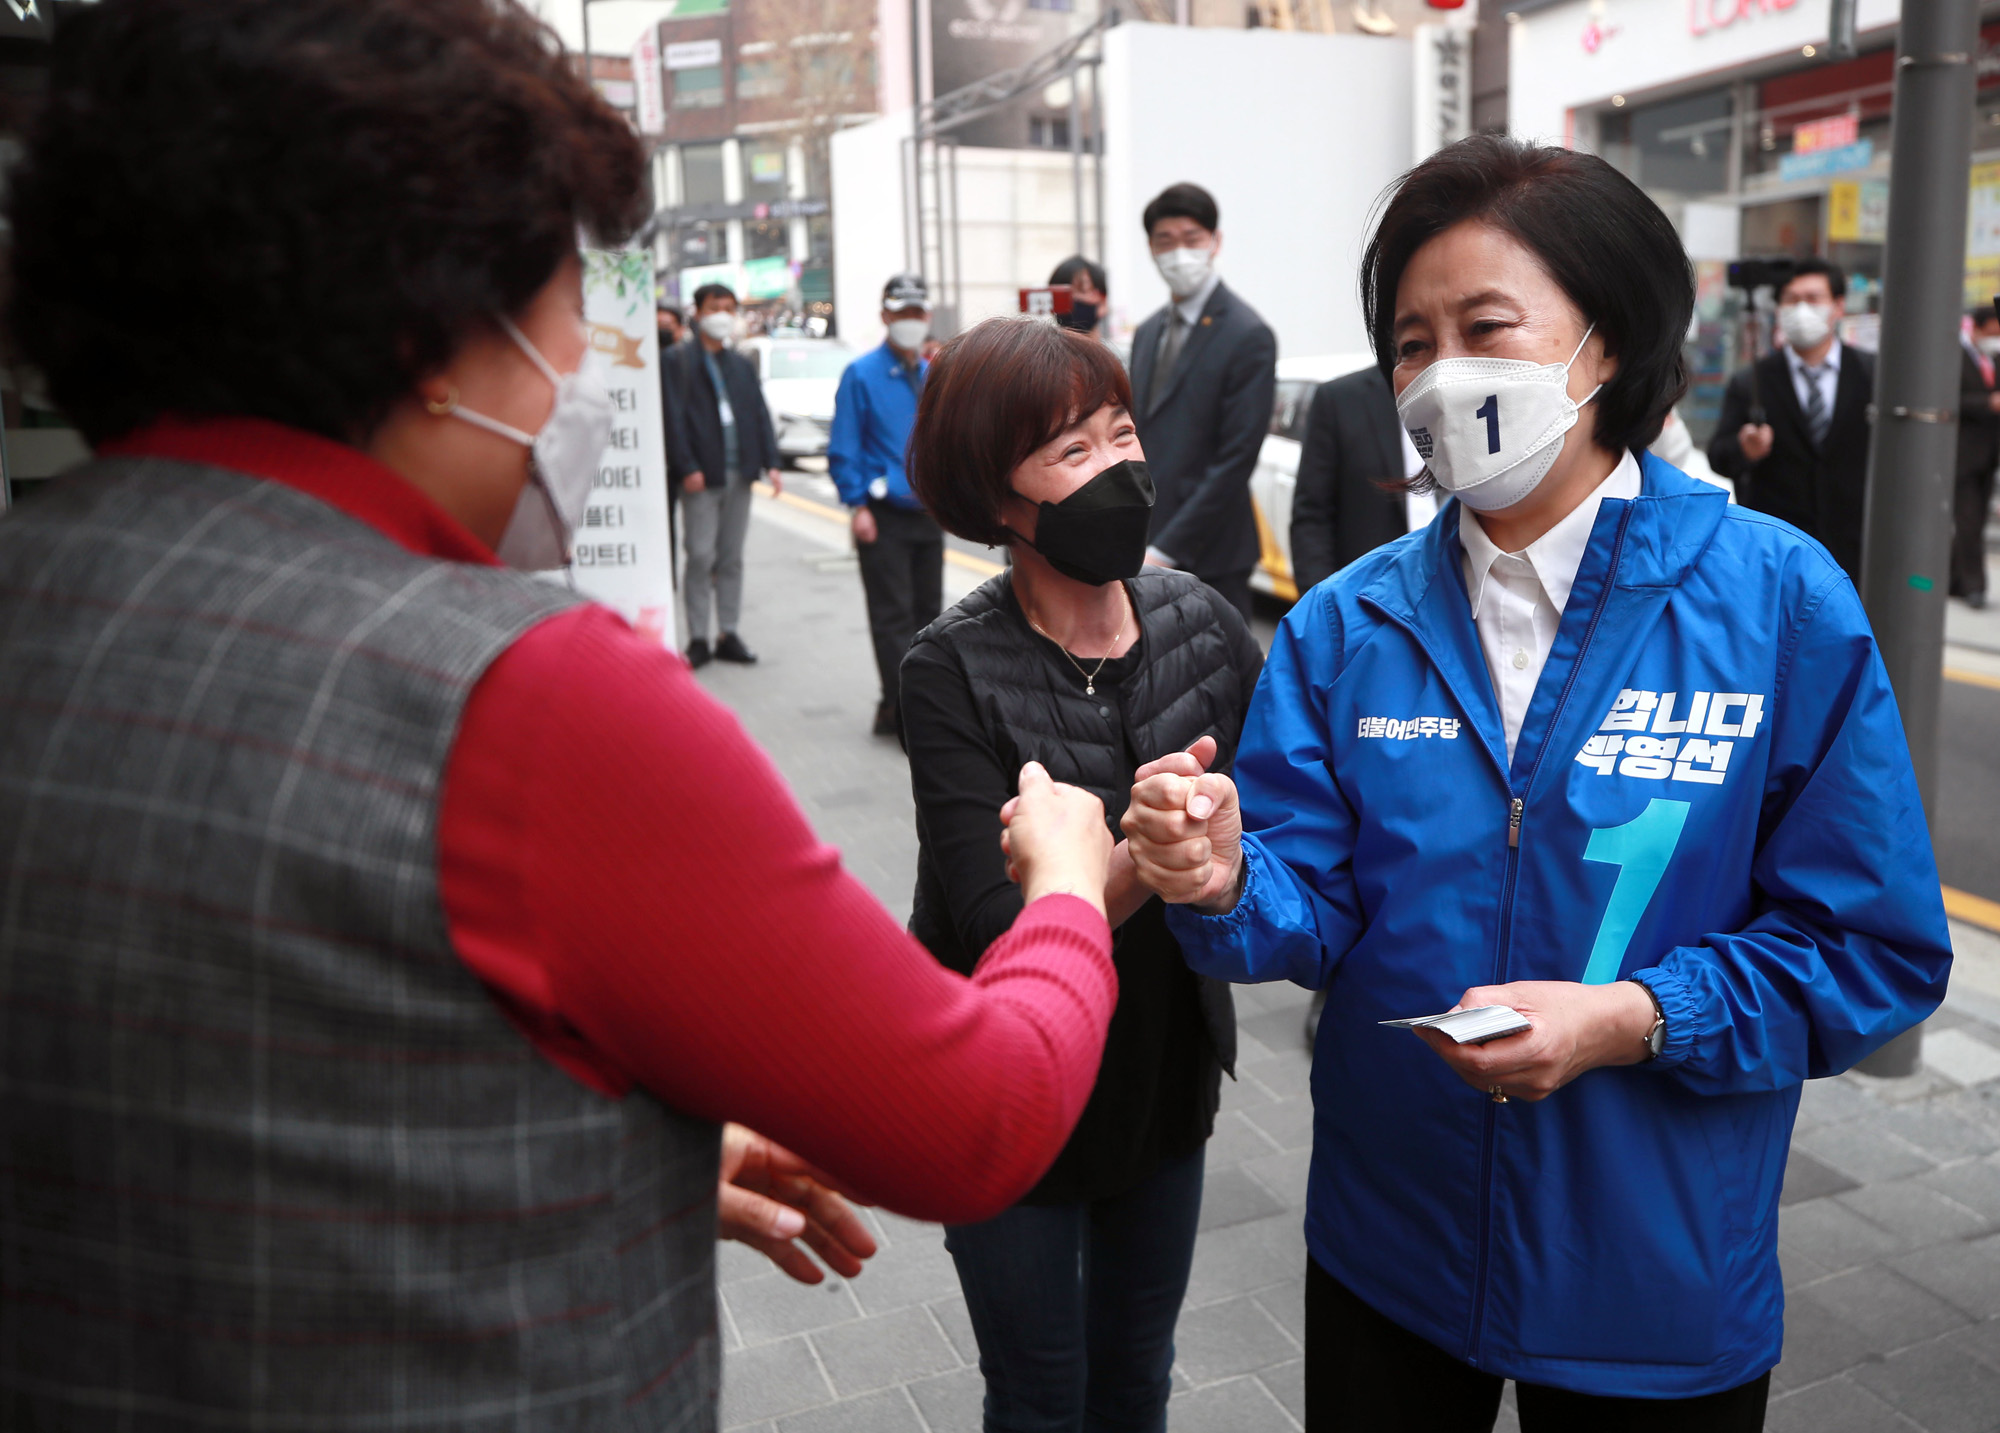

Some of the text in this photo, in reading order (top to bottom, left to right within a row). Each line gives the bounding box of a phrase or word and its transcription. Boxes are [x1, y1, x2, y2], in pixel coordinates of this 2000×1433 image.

[1476, 394, 1501, 455] 1
[1357, 716, 1462, 741] 더불어민주당
[1599, 688, 1765, 738] 합니다
[1583, 797, 1692, 986] 1
